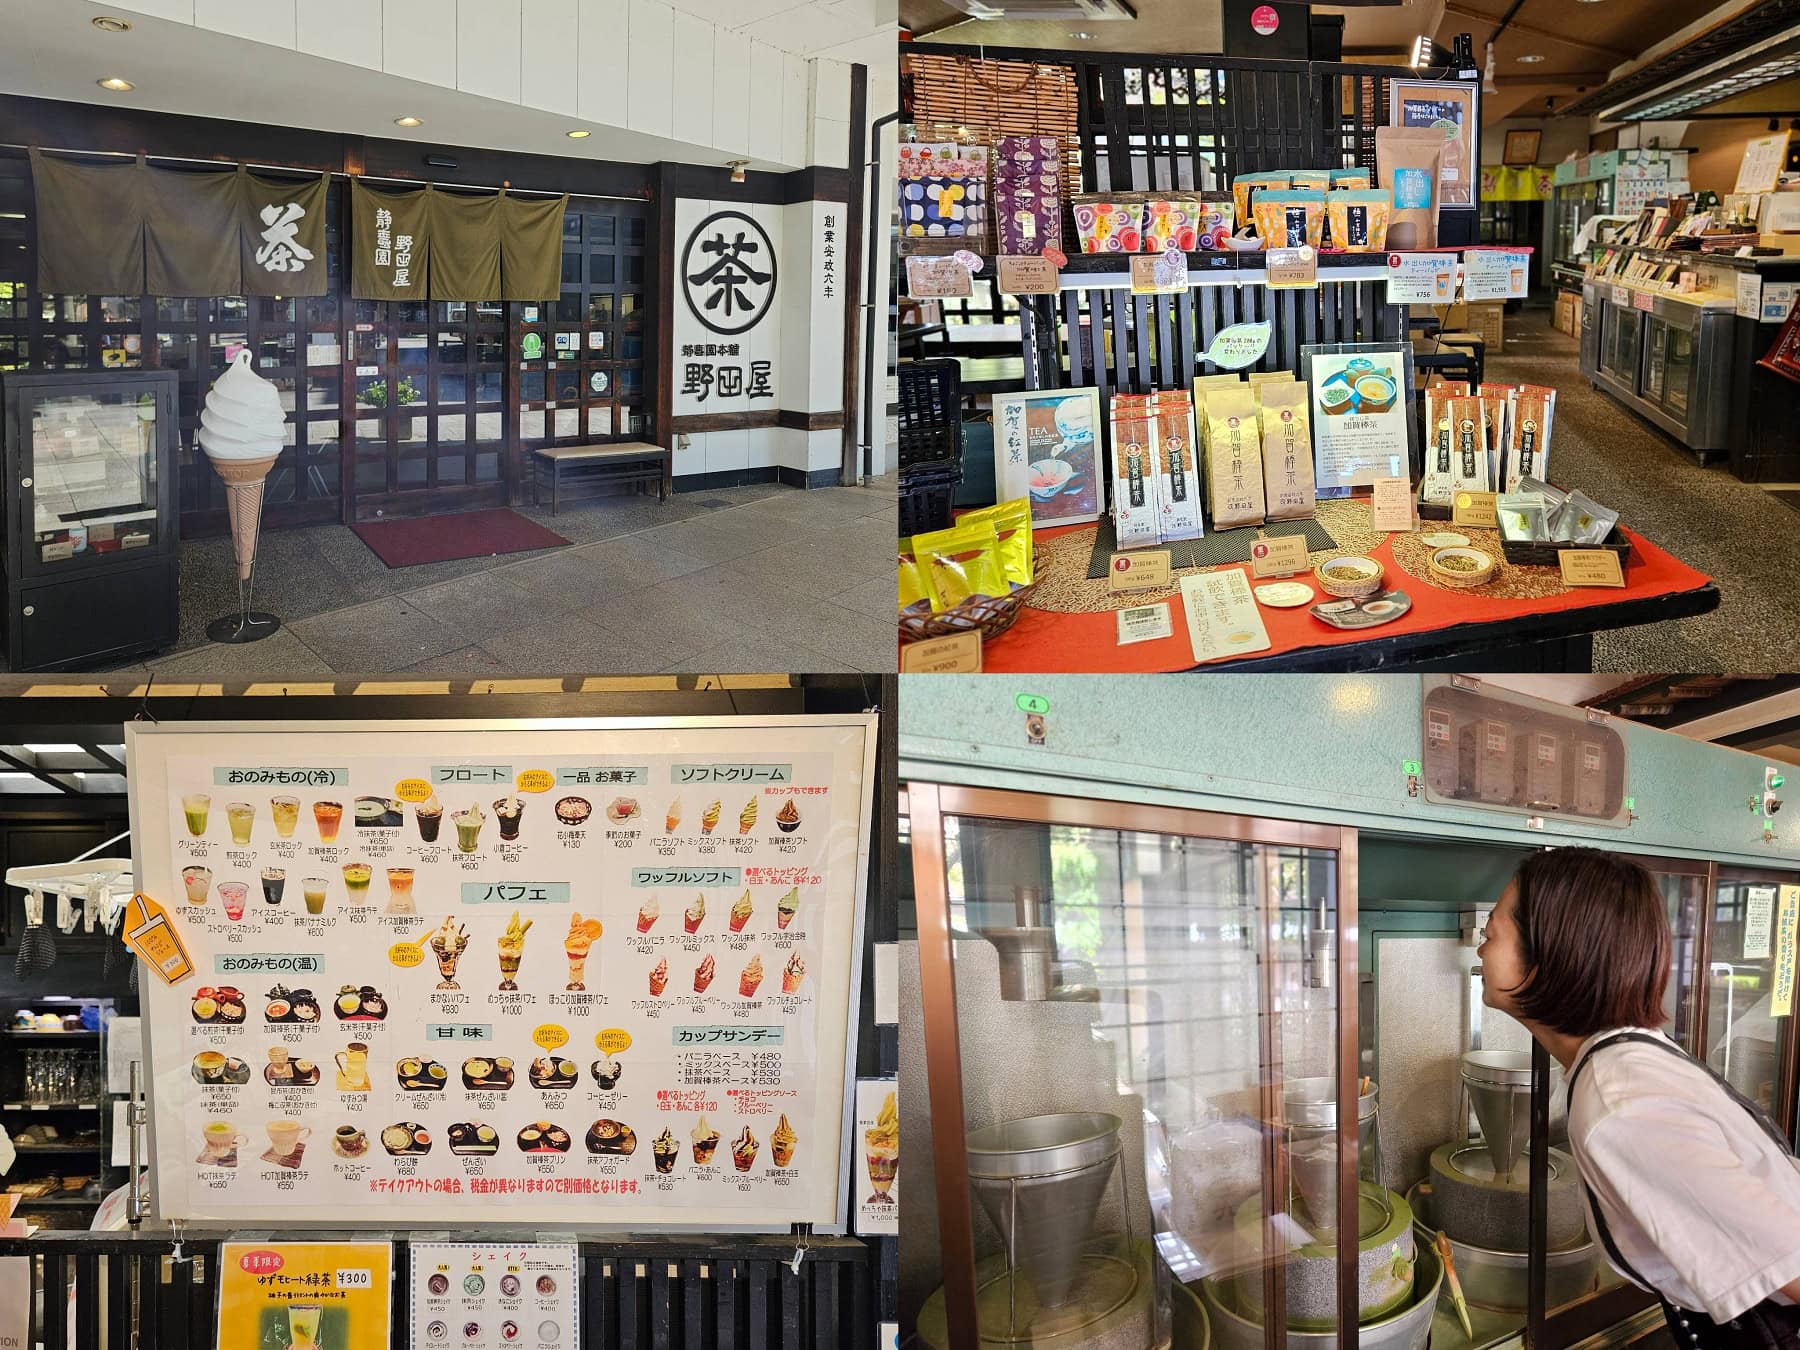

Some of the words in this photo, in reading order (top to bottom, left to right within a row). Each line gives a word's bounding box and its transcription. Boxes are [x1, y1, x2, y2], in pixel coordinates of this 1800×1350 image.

[256, 202, 315, 272] 茶
[392, 235, 413, 287] 野田屋
[823, 214, 836, 299] 創業安政六年
[687, 231, 773, 317] 茶
[1024, 283, 1046, 291] ¥200
[1416, 291, 1432, 299] ¥756
[679, 360, 774, 402] 野田屋
[1343, 420, 1379, 430] 加賀棒茶
[1029, 426, 1049, 436] TEA
[932, 661, 958, 673] ¥900
[1028, 698, 1037, 710] 4
[1408, 763, 1415, 774] 3
[228, 770, 336, 786] おのみもの(冷)
[439, 768, 506, 781] フロート
[562, 771, 591, 783] 一品
[595, 771, 638, 783] お菓子
[681, 768, 785, 781] ソフトクリーム
[605, 830, 642, 840] 季節のお菓子
[178, 840, 219, 849] グリーンティー
[270, 841, 303, 850] 玄米茶ロック
[562, 840, 581, 849] ¥130
[613, 840, 633, 849] ¥200
[649, 838, 686, 847] バニラソフト
[687, 838, 727, 846] ミックスソフト
[729, 838, 760, 846] 抹茶ソフト
[768, 837, 808, 845] 加賀棒茶ソフト
[190, 849, 208, 857] ¥500
[406, 846, 452, 855] コーヒーフロート
[493, 844, 529, 853] 小倉コーヒー
[658, 847, 676, 856] ¥350
[735, 845, 753, 854] ¥420
[779, 845, 797, 853] ¥420
[226, 851, 258, 860] 煎茶ロック
[278, 850, 295, 859] ¥400
[452, 854, 488, 862] 抹茶フロート
[502, 854, 520, 863] ¥650
[232, 860, 252, 868] ¥400
[320, 855, 338, 864] ¥400
[421, 855, 439, 864] ¥600
[461, 862, 479, 871] ¥600
[638, 872, 733, 884] ワッフルソフト
[482, 886, 548, 901] パフェ
[176, 907, 217, 916] ゆずスカッシュ
[251, 909, 296, 918] アイスコーヒー
[337, 906, 378, 915] アイス抹茶ラテ
[187, 915, 206, 924] ¥500
[264, 917, 284, 925] ¥400
[294, 918, 337, 927] 抹茶バナナミルク
[350, 915, 367, 924] ¥500
[377, 917, 425, 926] アイス加賀棒茶ラテ
[207, 925, 262, 934] ストロベリースカッシュ
[393, 926, 409, 935] ¥500
[227, 934, 243, 943] ¥500
[626, 936, 665, 946] ワッフルバニラ
[669, 935, 715, 943] ワッフルミックス
[721, 934, 756, 943] ワッフル抹茶
[761, 932, 807, 941] ワッフル宇治金時
[637, 945, 654, 954] ¥420
[683, 943, 701, 952] ¥450
[729, 942, 748, 951] ¥480
[774, 940, 792, 950] ¥600
[223, 957, 318, 972] おのみもの(温)
[430, 993, 471, 1004] まかないパフェ
[487, 993, 537, 1004] めっちゃ抹茶パフェ
[548, 994, 609, 1005] ほっこり加賀棒茶パフェ
[767, 996, 813, 1005] ワッフルチョコレート
[631, 1000, 675, 1009] ワッフルストロベリー
[501, 1004, 523, 1015] ¥1000
[567, 1005, 590, 1016] ¥1000
[209, 1036, 227, 1045] ¥500
[282, 1034, 302, 1043] ¥500
[354, 1031, 373, 1041] ¥500
[678, 1030, 781, 1042] カップサンデー
[751, 1052, 782, 1060] ¥480
[751, 1069, 782, 1077] ¥530
[751, 1077, 782, 1085] ¥530
[211, 1093, 232, 1101] ¥650
[284, 1094, 301, 1102] ¥400
[540, 1092, 568, 1101] あんみつ
[586, 1092, 629, 1101] コーヒーゼリー
[347, 1103, 363, 1112] ¥400
[543, 1101, 565, 1110] ¥650
[598, 1101, 617, 1110] ¥450
[694, 1101, 718, 1111] 各¥120
[284, 1108, 302, 1116] ¥400
[461, 1157, 487, 1167] ぜんざい
[333, 1164, 372, 1173] ホットコーヒー
[197, 1171, 237, 1181] HOT抹茶ラテ
[260, 1171, 309, 1181] HOT加賀棒茶ラテ
[344, 1173, 361, 1181] ¥400
[277, 1180, 295, 1190] ¥550
[471, 1251, 528, 1261] シェイク
[257, 1272, 332, 1288] ゆずモヒート緑茶
[337, 1271, 368, 1285] ¥300
